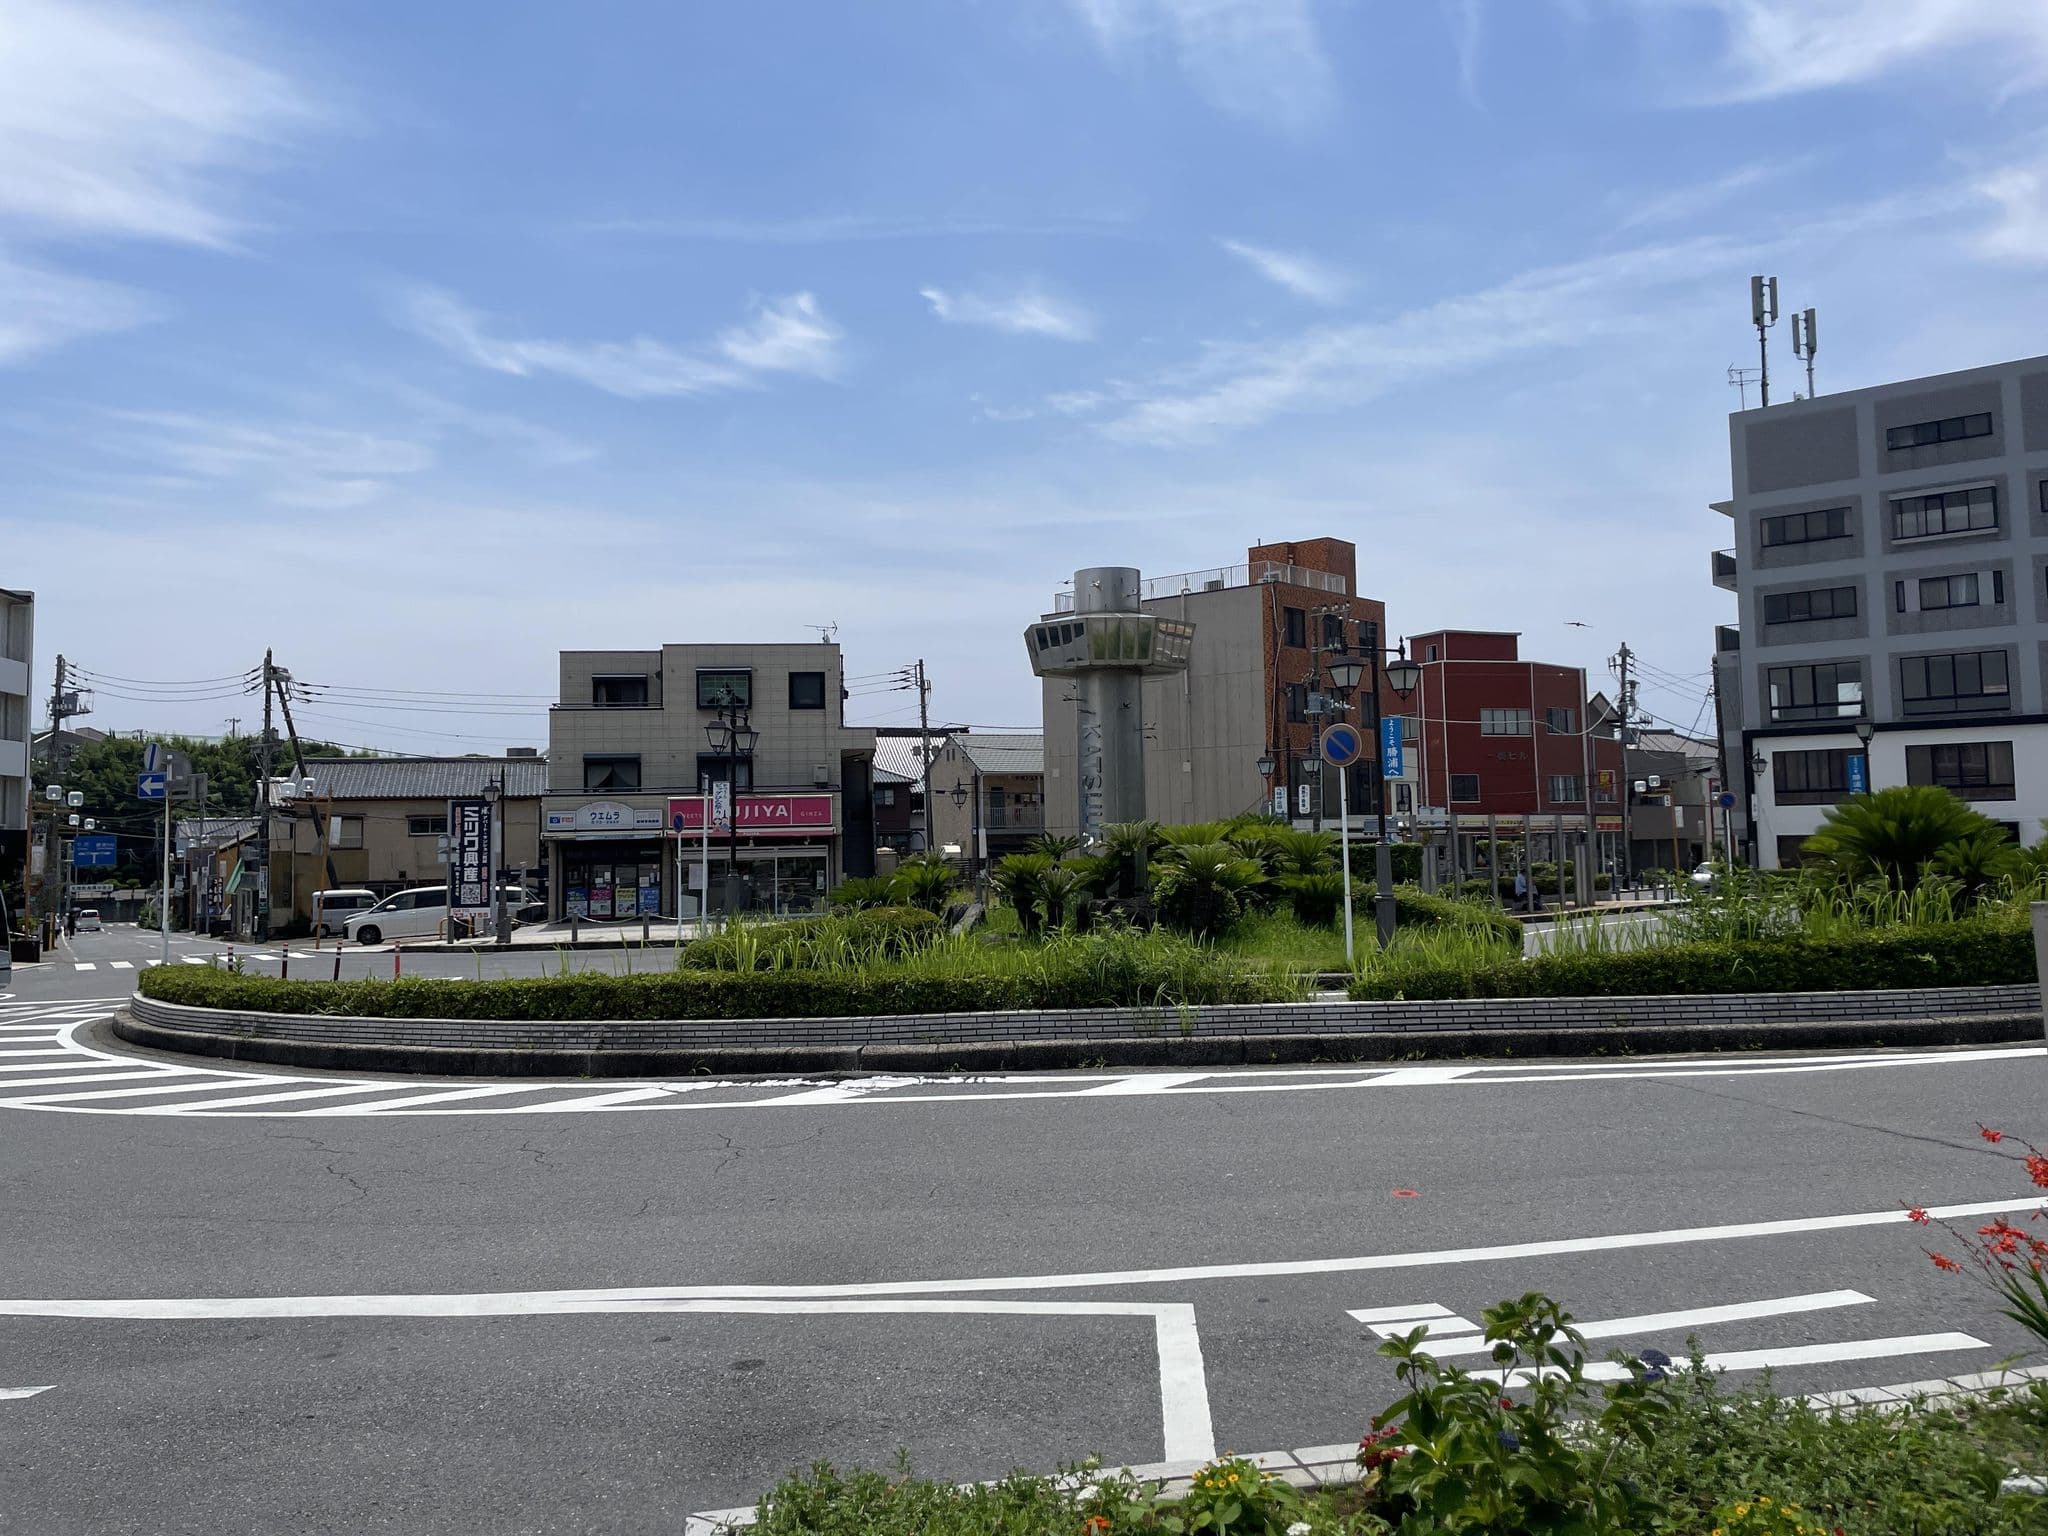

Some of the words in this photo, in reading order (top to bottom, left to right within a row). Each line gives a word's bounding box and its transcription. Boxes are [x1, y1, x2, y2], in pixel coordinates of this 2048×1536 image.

[1387, 719, 1400, 775] ようこそ勝浦へ
[463, 806, 480, 882] ミツワ興産
[590, 811, 621, 821] ウエムラ
